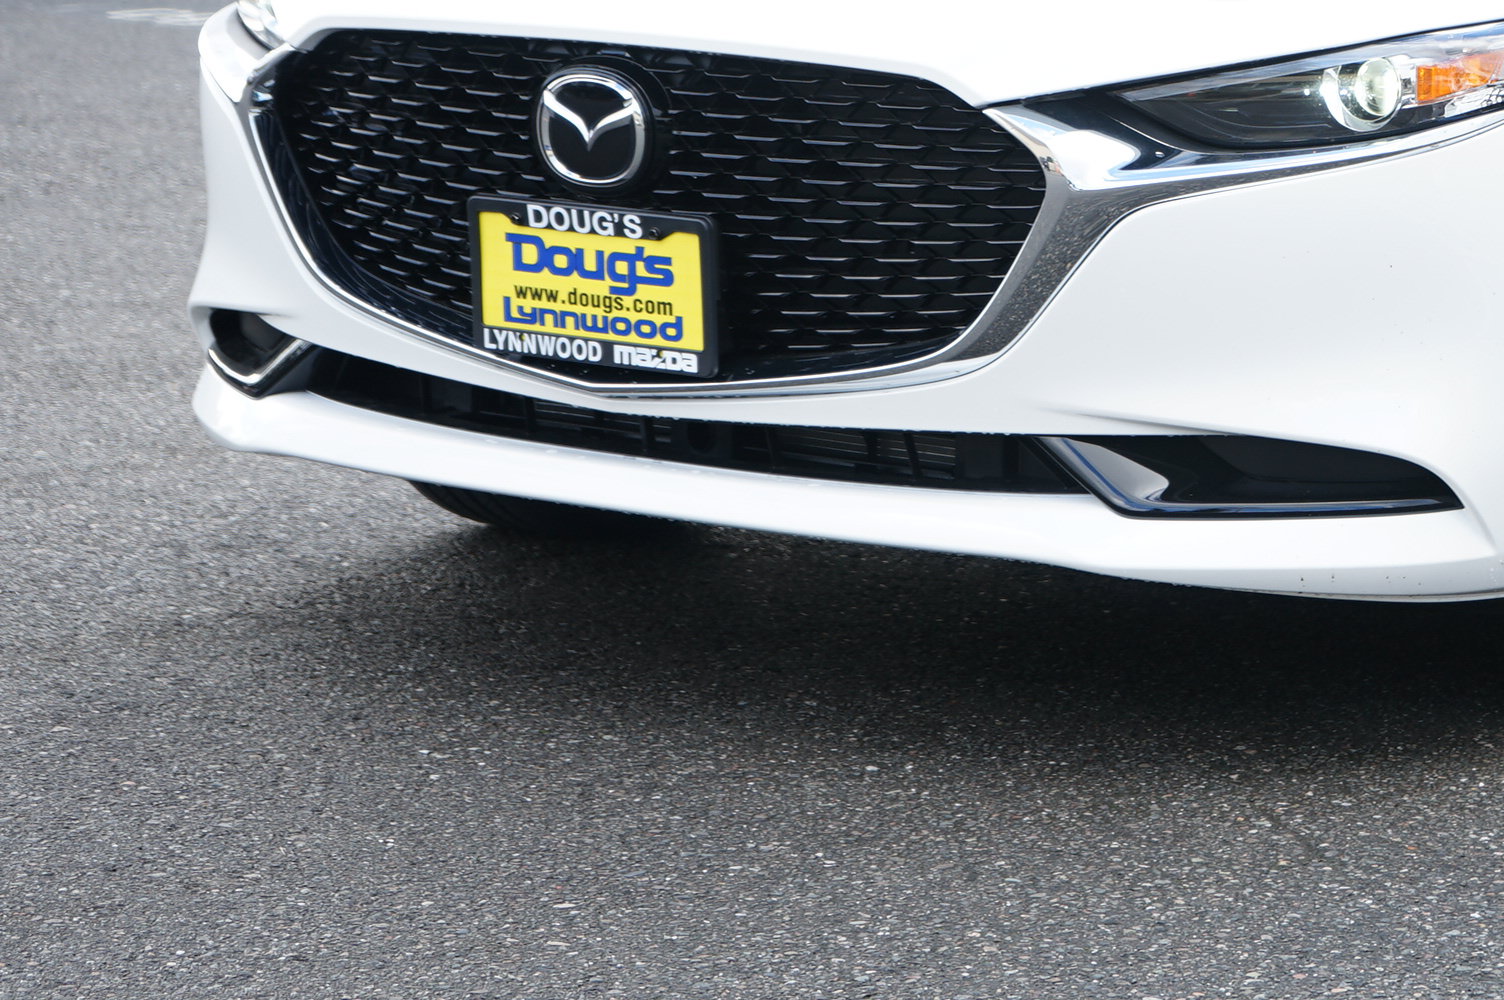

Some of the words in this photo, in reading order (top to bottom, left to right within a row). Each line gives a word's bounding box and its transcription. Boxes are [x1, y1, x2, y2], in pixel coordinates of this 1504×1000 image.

[526, 204, 643, 239] DOUG'S
[514, 285, 674, 316] www.dougs.com
[503, 296, 683, 342] Lynnwood
[483, 328, 601, 362] LYNNWOOD
